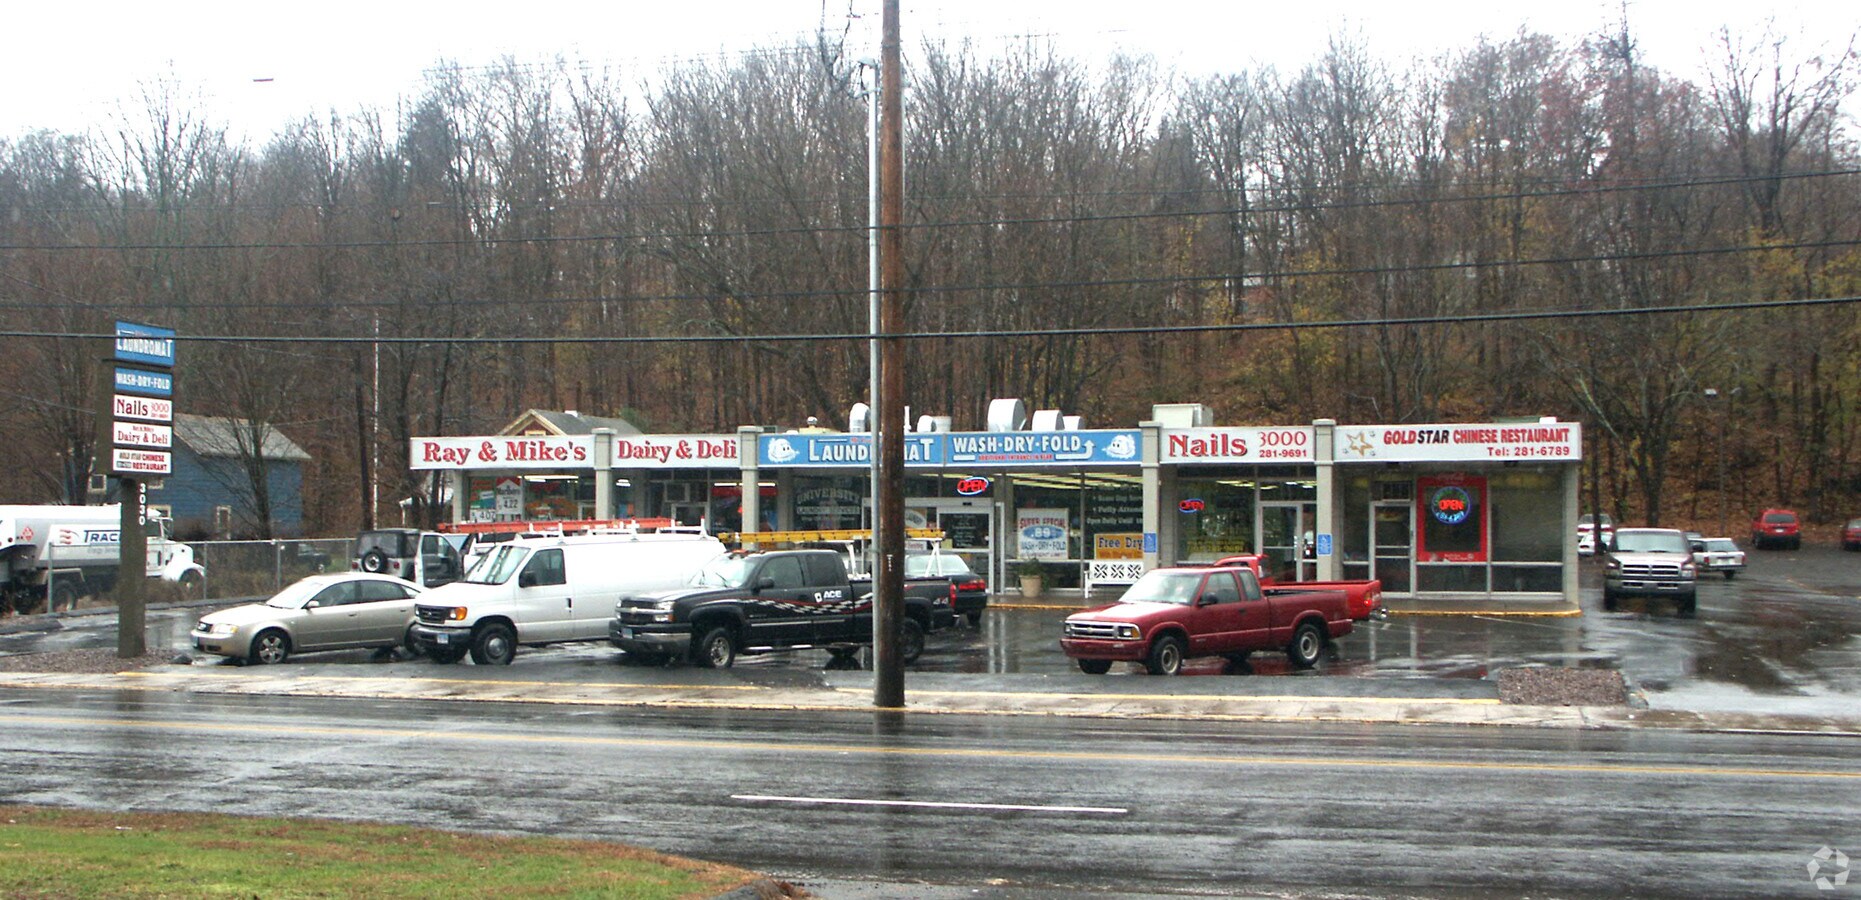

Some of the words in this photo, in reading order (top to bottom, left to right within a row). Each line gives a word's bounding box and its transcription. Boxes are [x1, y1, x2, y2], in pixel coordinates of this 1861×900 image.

[117, 330, 173, 358] LAUNDROMAT
[116, 399, 149, 416] Nails
[117, 430, 140, 445] Dairy
[143, 433, 149, 443] &
[152, 434, 168, 444] Deli
[1453, 429, 1498, 444] CHINESE
[1501, 428, 1570, 443] RESTAURANT
[617, 440, 672, 463] Dairy
[676, 440, 693, 459] &
[697, 439, 737, 459] Deli
[1168, 433, 1248, 457] Nails
[1258, 431, 1307, 446] 3000
[142, 453, 165, 463] CHINESE
[423, 442, 471, 465] Ray
[478, 441, 498, 462] &
[505, 441, 587, 462] Mike's
[1259, 449, 1307, 458] 281-9691
[1487, 447, 1510, 457] Tel:
[1514, 446, 1570, 456] 281-6789
[132, 462, 168, 472] RESTAURANT
[958, 479, 987, 492] OPEN
[138, 483, 147, 526] 3030
[1439, 499, 1464, 511] OPEN
[84, 529, 121, 543] TRAC
[1098, 537, 1121, 548] Free
[823, 590, 842, 599] ACE
